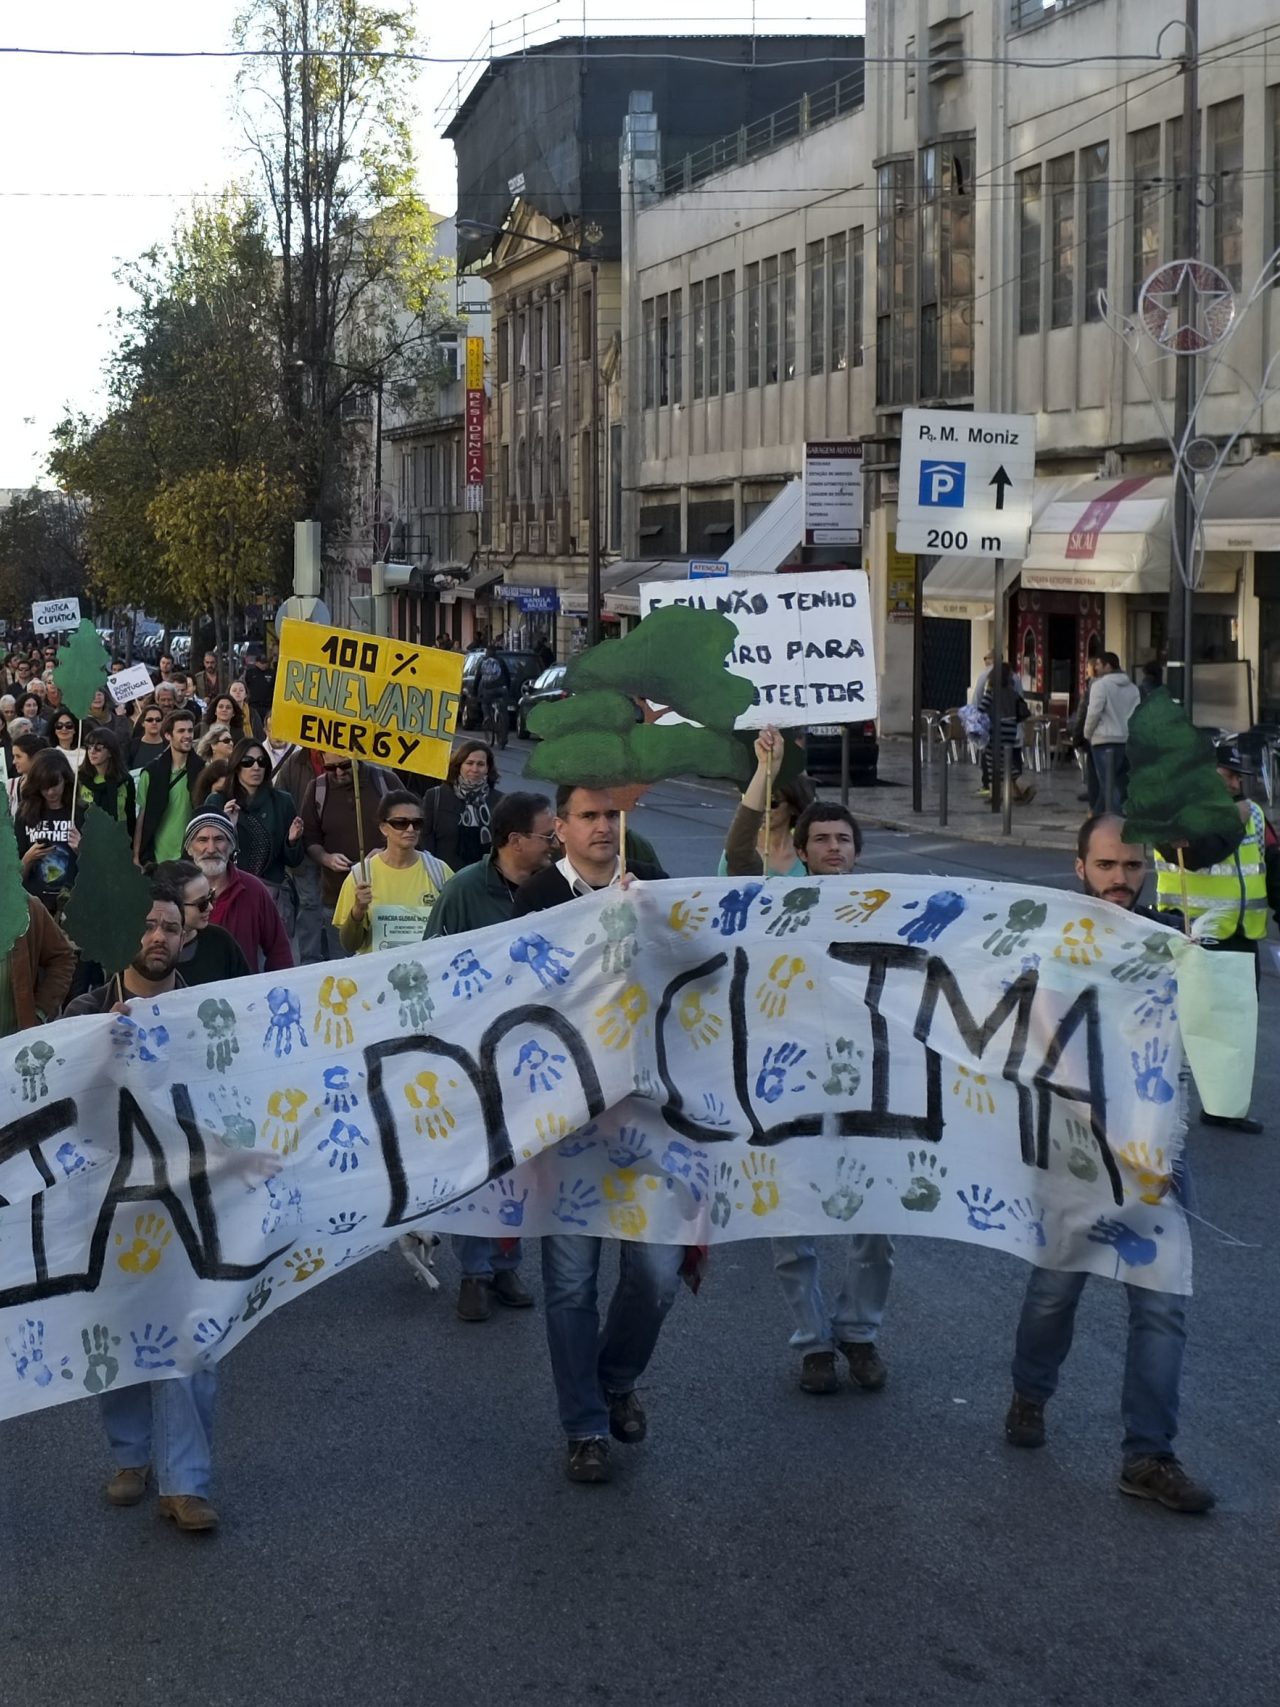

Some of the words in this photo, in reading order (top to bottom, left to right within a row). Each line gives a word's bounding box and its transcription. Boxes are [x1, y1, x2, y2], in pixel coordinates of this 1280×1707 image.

[469, 392, 481, 482] RESIDENCIAL
[940, 426, 959, 442] M.
[968, 428, 1019, 445] Moniz
[931, 472, 954, 502] P
[927, 529, 968, 550] 200
[981, 536, 1001, 551] m
[693, 563, 726, 573] ATENÇÃO
[716, 589, 768, 616] NÃO
[777, 590, 857, 612] TENHO
[321, 635, 379, 673] 100
[391, 653, 419, 676] %
[786, 639, 865, 660] PARA
[115, 680, 149, 696] PORTUGAL
[284, 660, 461, 742] RENEWABLE
[300, 714, 420, 765] ENERGY
[656, 941, 1123, 1205] CLIMA
